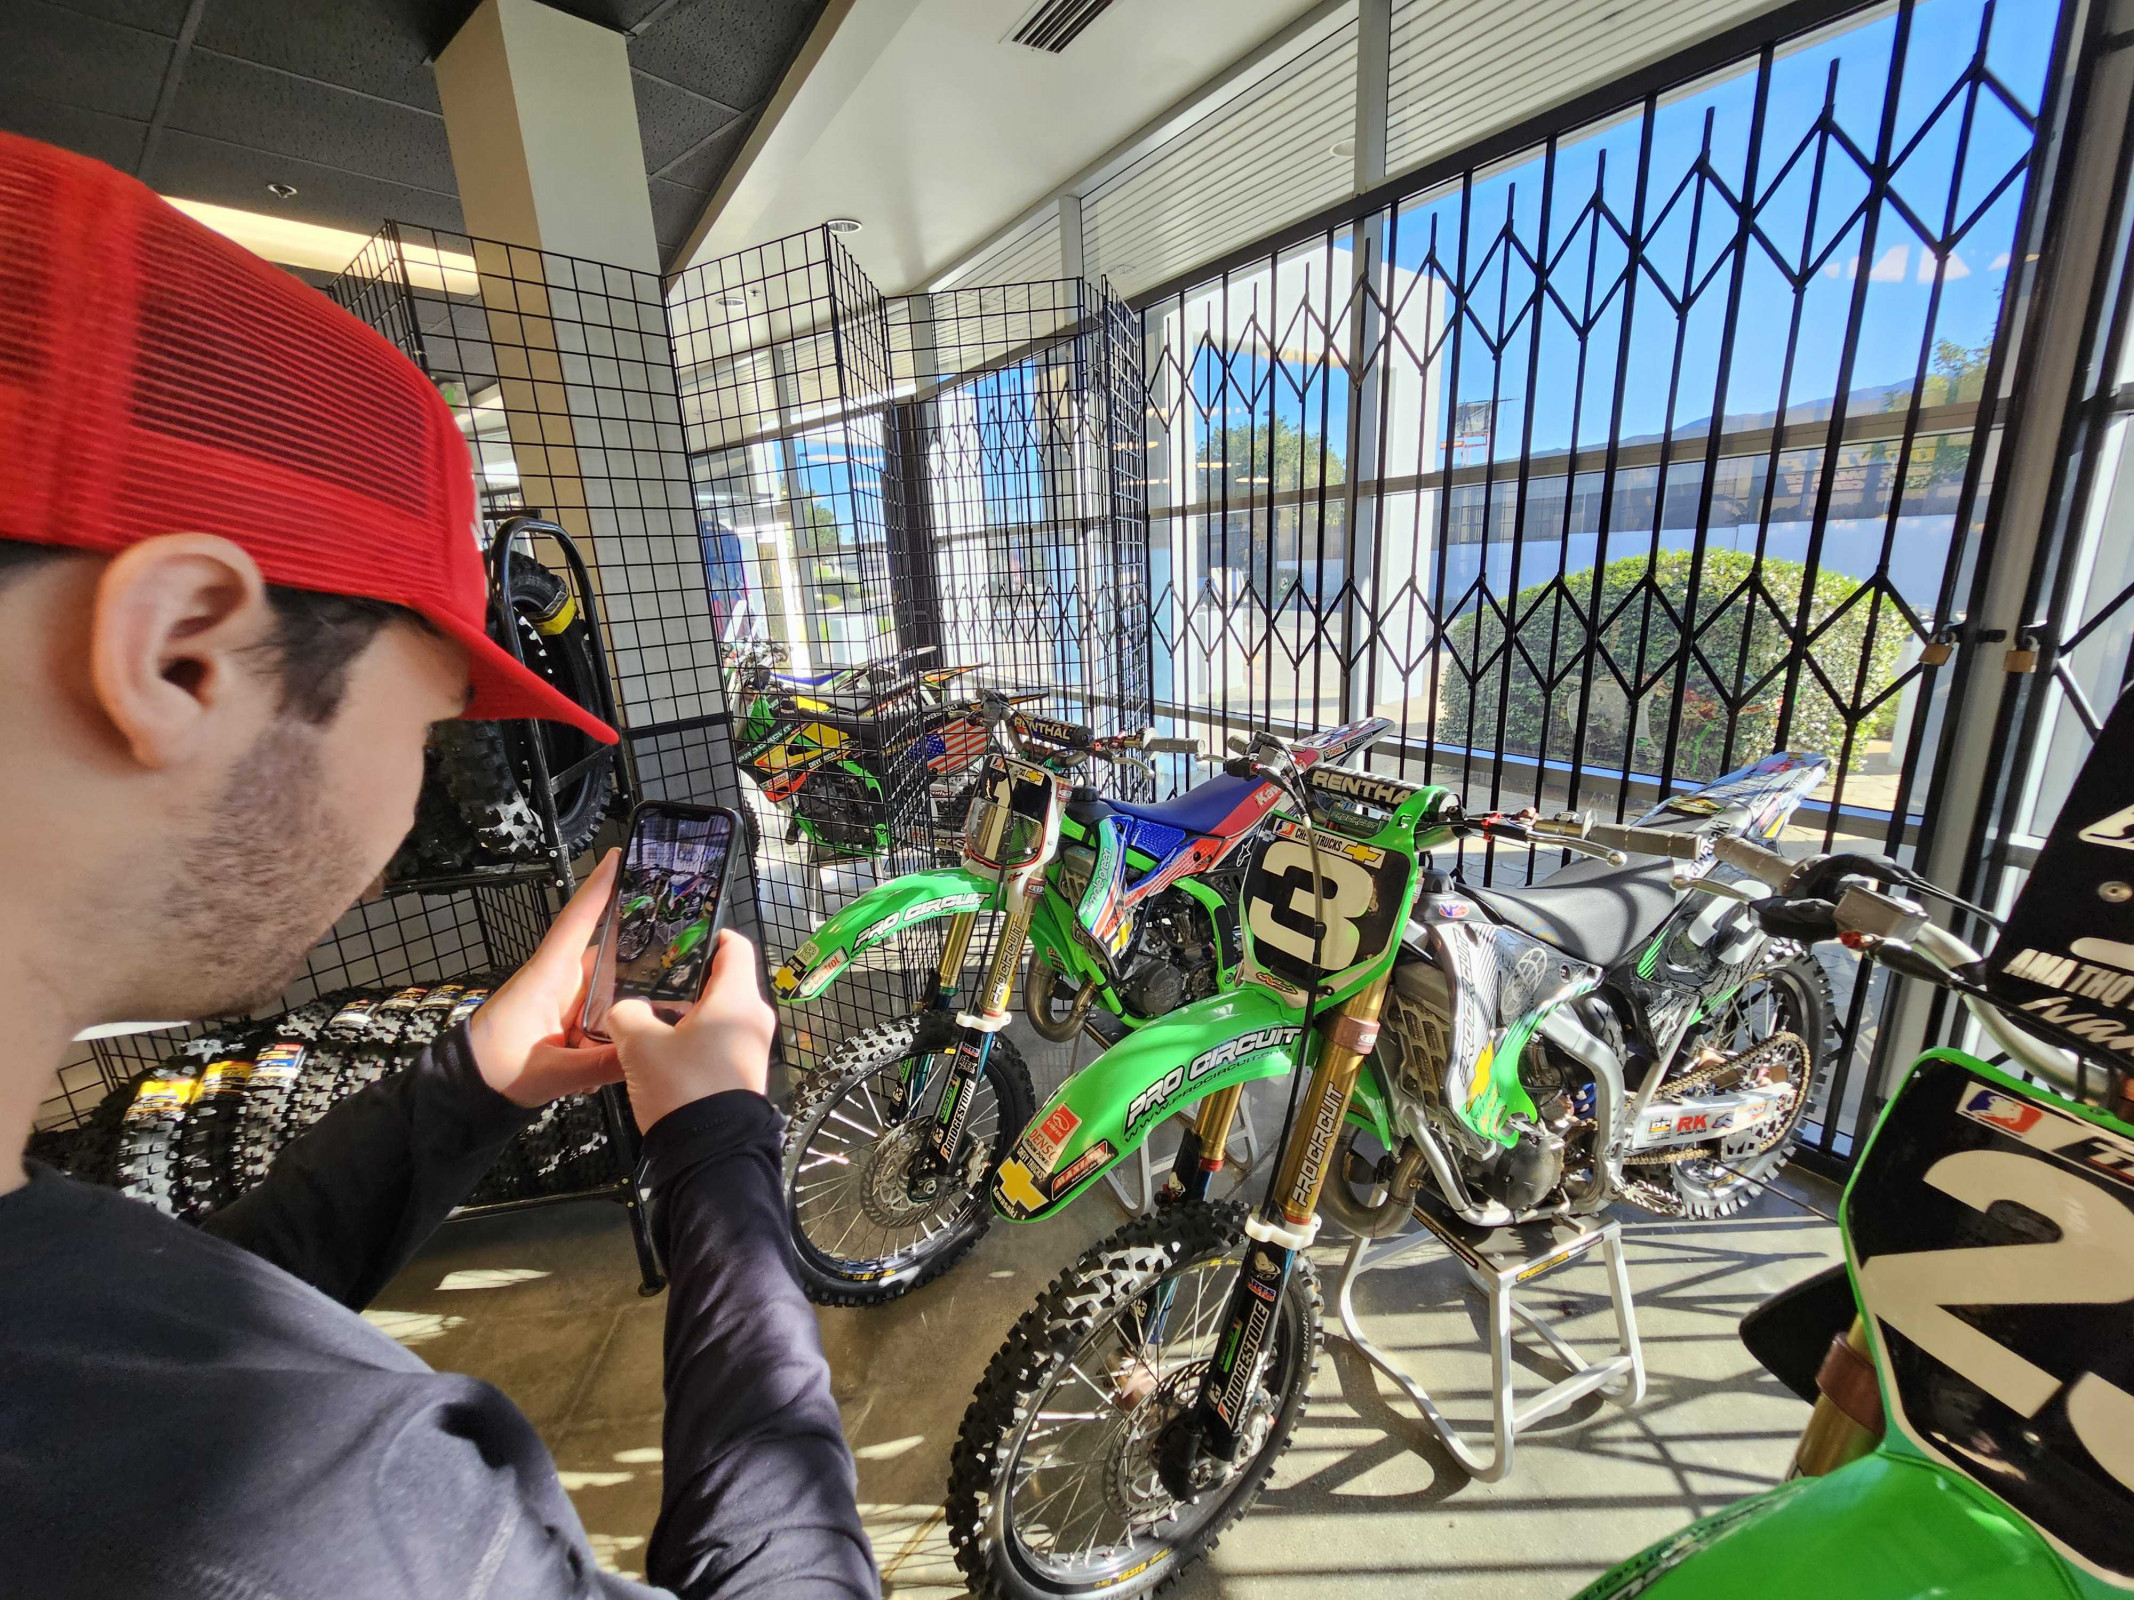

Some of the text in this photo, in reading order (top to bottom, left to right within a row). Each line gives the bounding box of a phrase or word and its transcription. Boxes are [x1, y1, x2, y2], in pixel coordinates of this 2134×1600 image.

[1013, 716, 1071, 741] RENTHAL
[1312, 769, 1412, 805] RENTHA
[1316, 834, 1343, 852] TRUCKS
[854, 911, 900, 950] PRO
[902, 892, 993, 922] CIRCUIT
[1249, 841, 1374, 971] 3
[810, 954, 841, 986] Castrol
[2002, 948, 2078, 988] AMA
[1124, 1026, 1304, 1137] PRO CIRCUIT
[941, 1078, 977, 1163] BRIDGESTONE
[1676, 1113, 1710, 1133] RK
[1291, 1080, 1346, 1208] PROCIRCUIT
[992, 1184, 1019, 1219] Kawasaki
[1217, 1299, 1271, 1431] BRIDGESTONE
